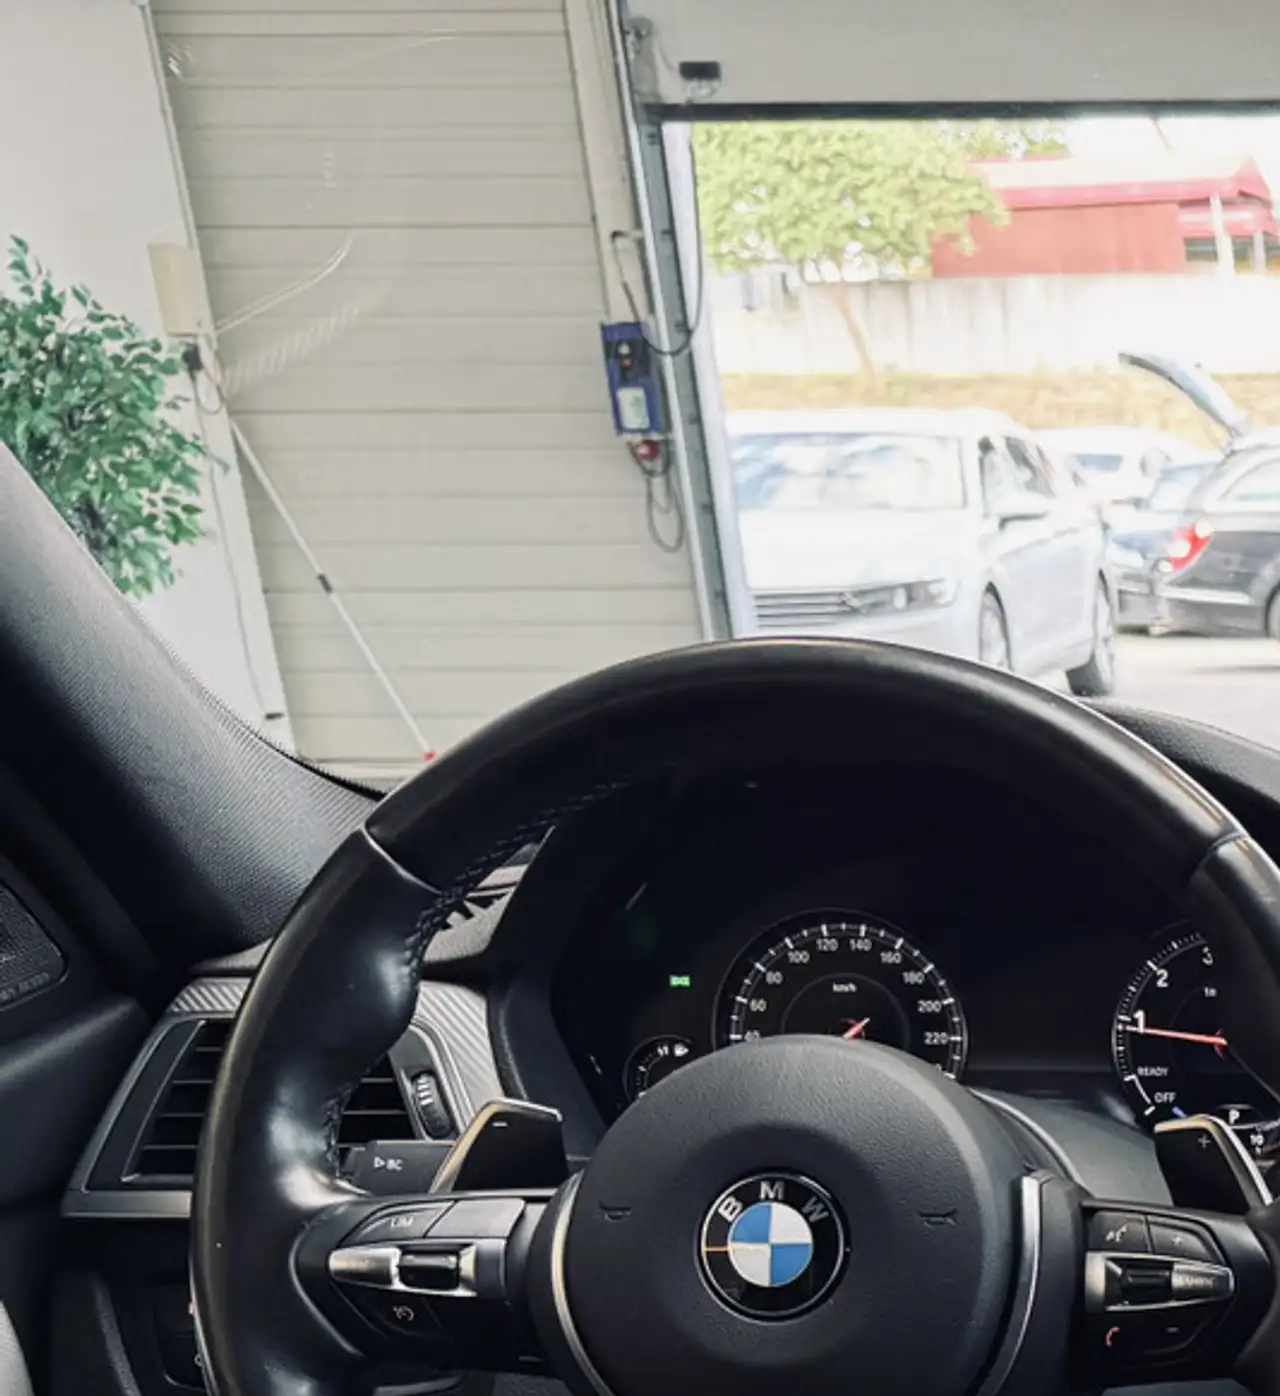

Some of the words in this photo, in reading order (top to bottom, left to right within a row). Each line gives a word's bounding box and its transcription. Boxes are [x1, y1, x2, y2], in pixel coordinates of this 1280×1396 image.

[816, 938, 838, 951] 120
[850, 938, 872, 951] 140
[788, 950, 810, 964] 100
[880, 950, 902, 964] 160
[766, 970, 784, 984] 80
[903, 970, 925, 984] 180
[1155, 968, 1169, 988] 2
[751, 999, 767, 1012] 60
[918, 1000, 942, 1013] 200
[1133, 1009, 1147, 1034] 1
[924, 1031, 948, 1045] 220
[1137, 1066, 1170, 1077] READY
[1154, 1091, 1177, 1104] OFF
[1228, 1108, 1240, 1124] P
[718, 1180, 829, 1223] BMW
